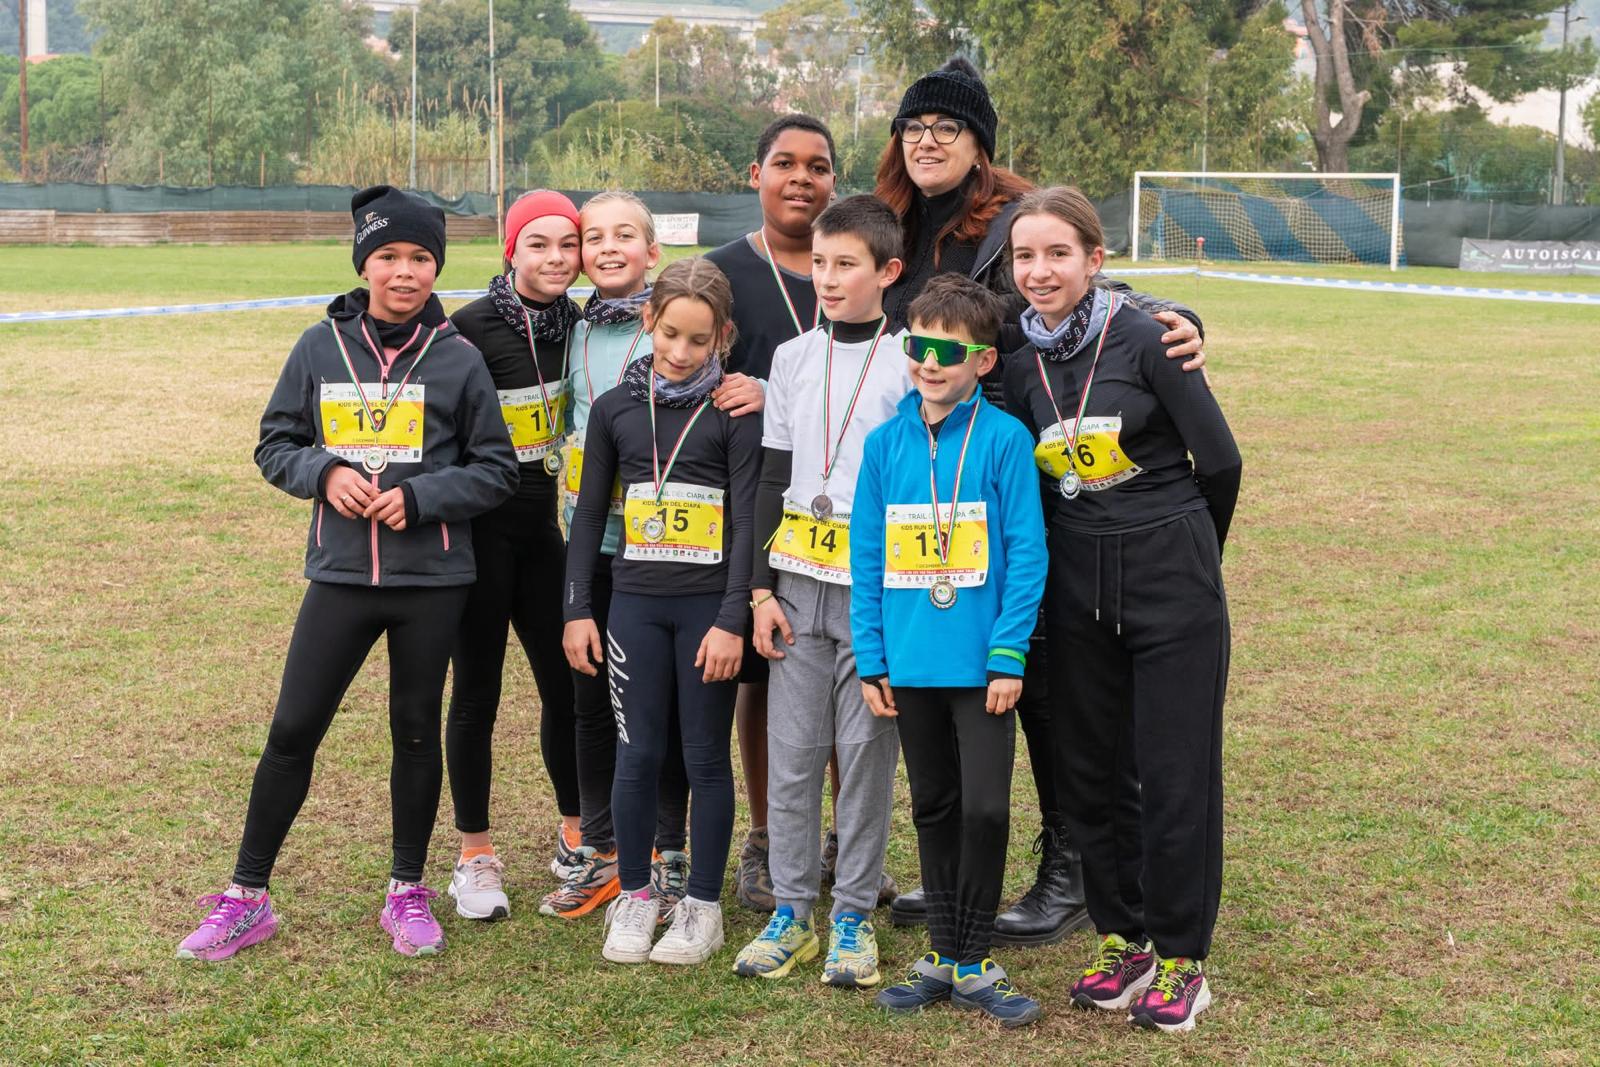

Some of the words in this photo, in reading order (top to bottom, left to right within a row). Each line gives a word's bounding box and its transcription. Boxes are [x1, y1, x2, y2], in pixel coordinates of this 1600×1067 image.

[356, 218, 388, 244] GUINNESS
[1061, 444, 1095, 469] 16
[657, 508, 689, 532] 15
[809, 526, 836, 552] 14
